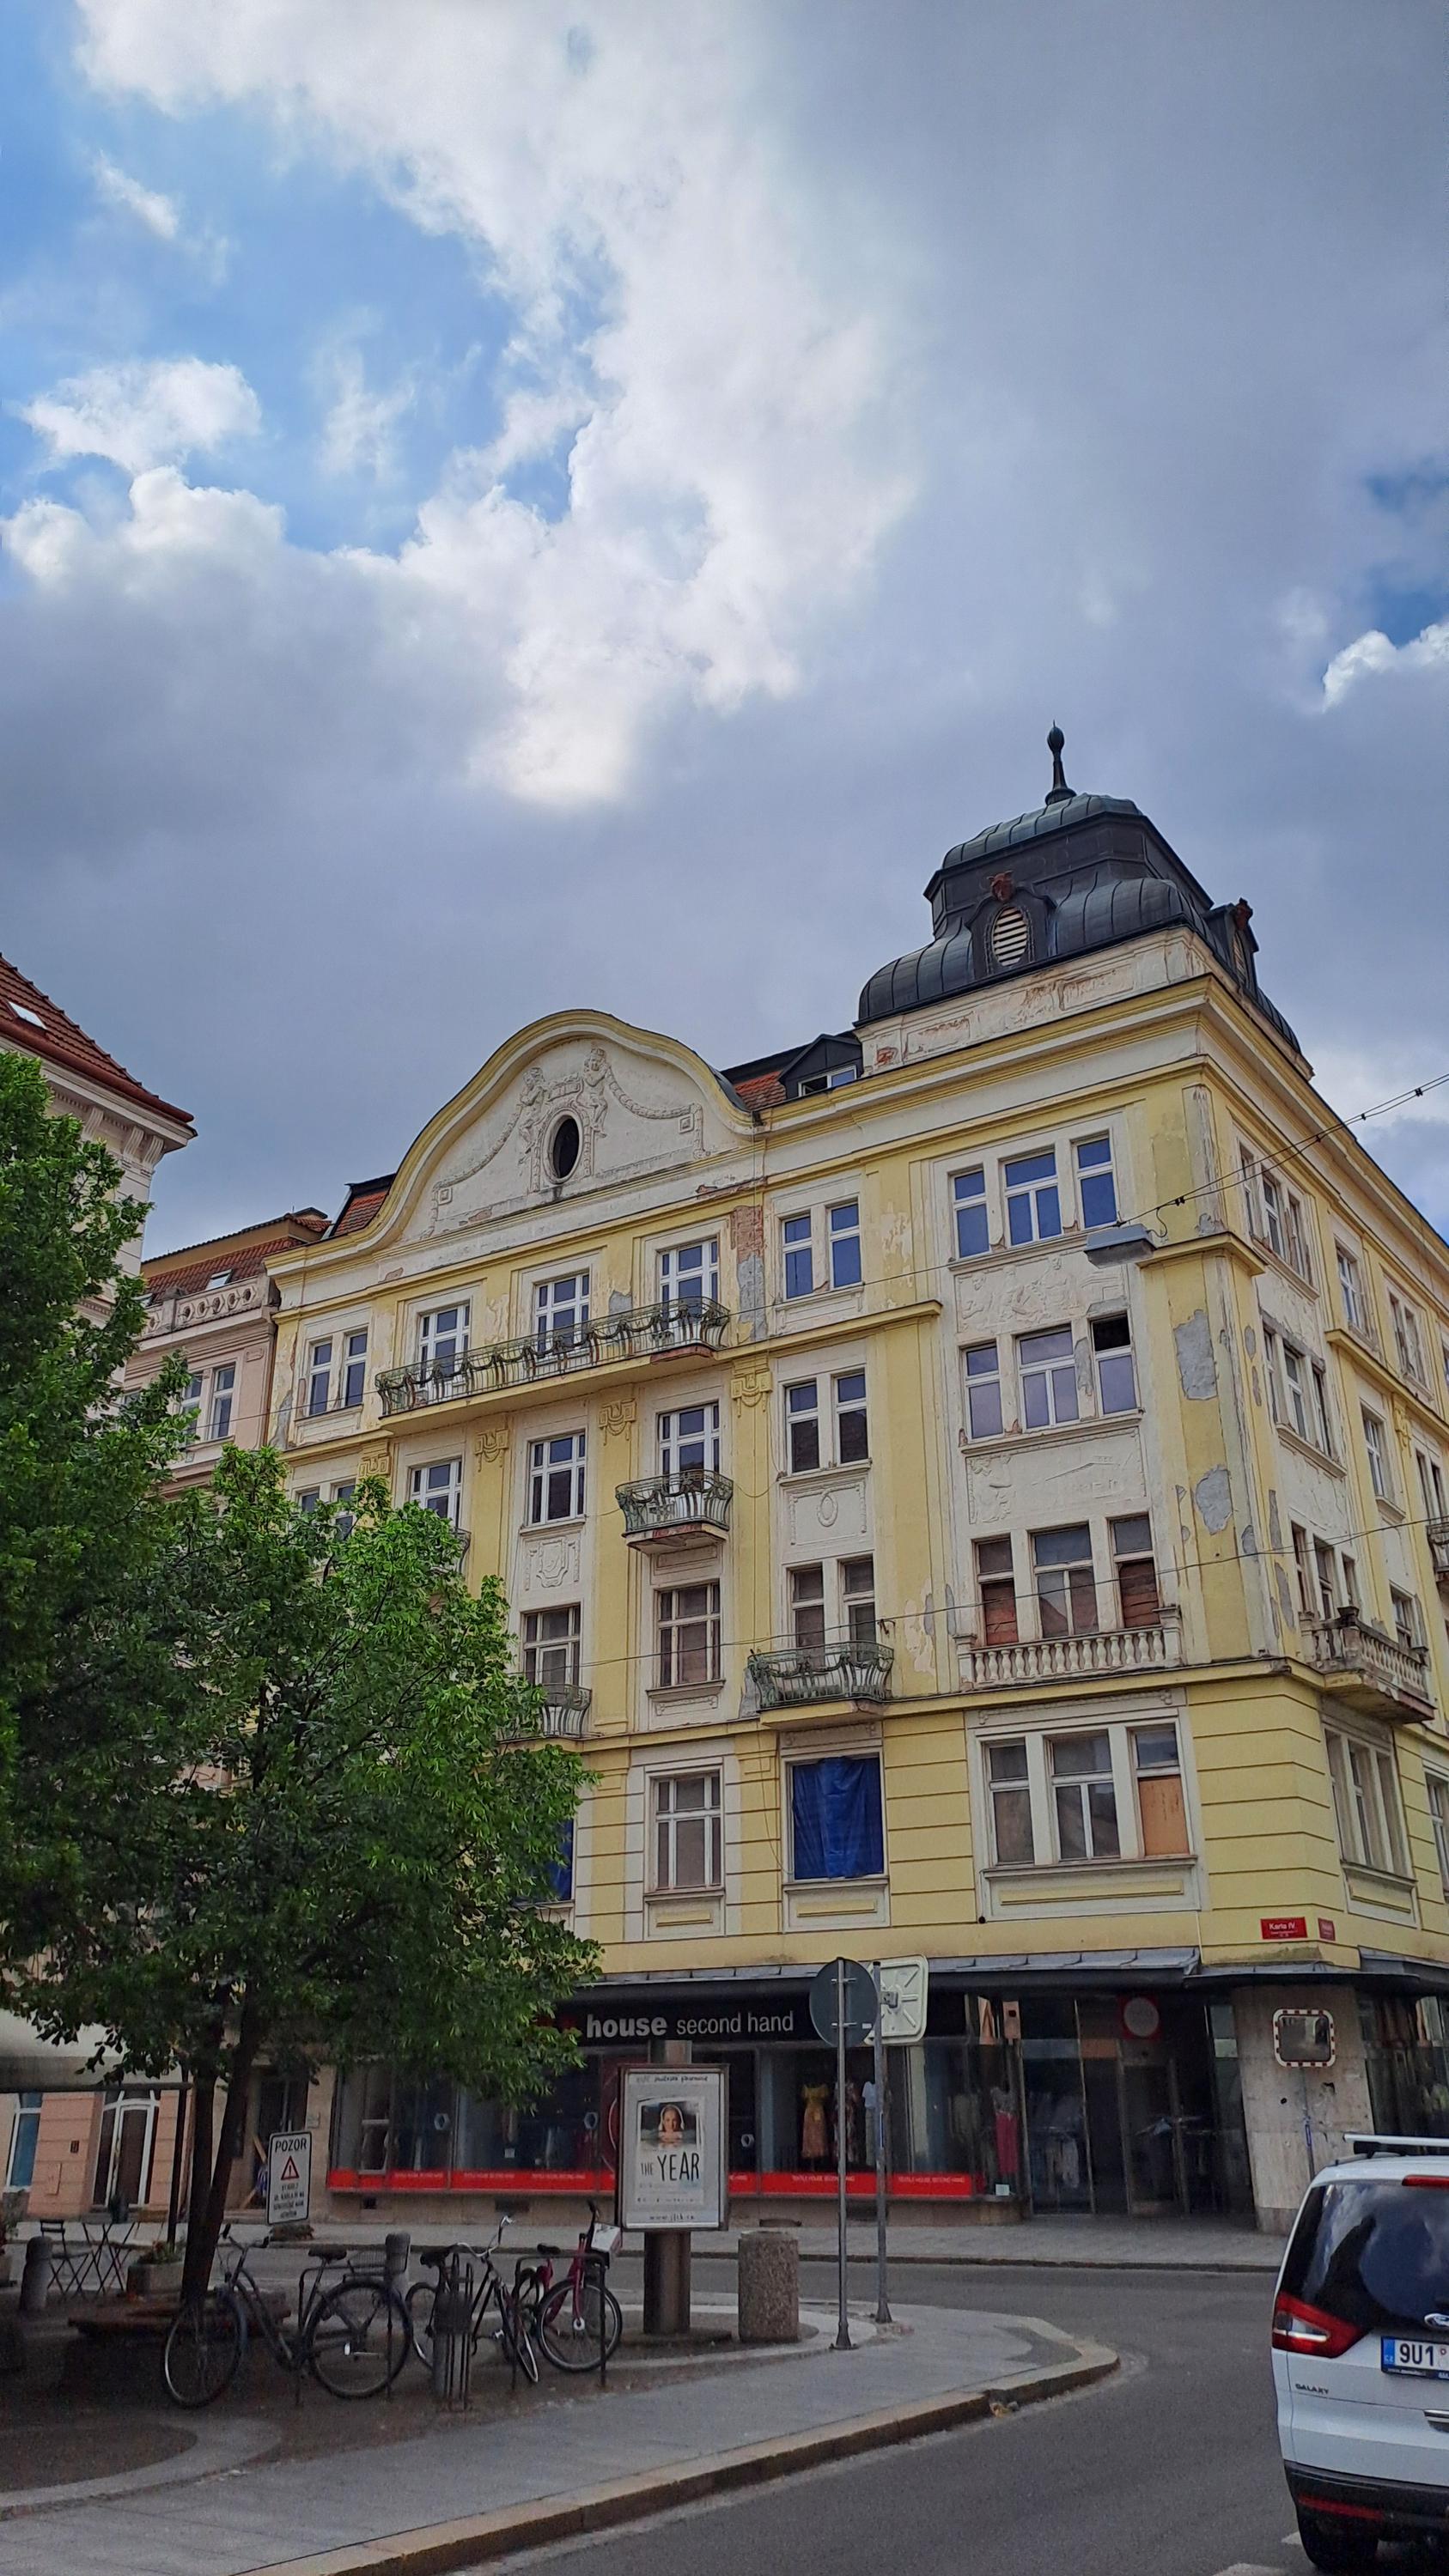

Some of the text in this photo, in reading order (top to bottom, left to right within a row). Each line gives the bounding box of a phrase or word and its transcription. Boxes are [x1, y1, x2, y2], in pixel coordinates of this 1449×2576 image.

[586, 2013, 667, 2038] house
[676, 2012, 741, 2035] second
[747, 2010, 794, 2032] hand
[275, 2138, 307, 2153] POZOR
[640, 2152, 700, 2182] THE YEAR
[1399, 2342, 1434, 2367] 9U1
[1294, 2383, 1330, 2395] GALAXY
